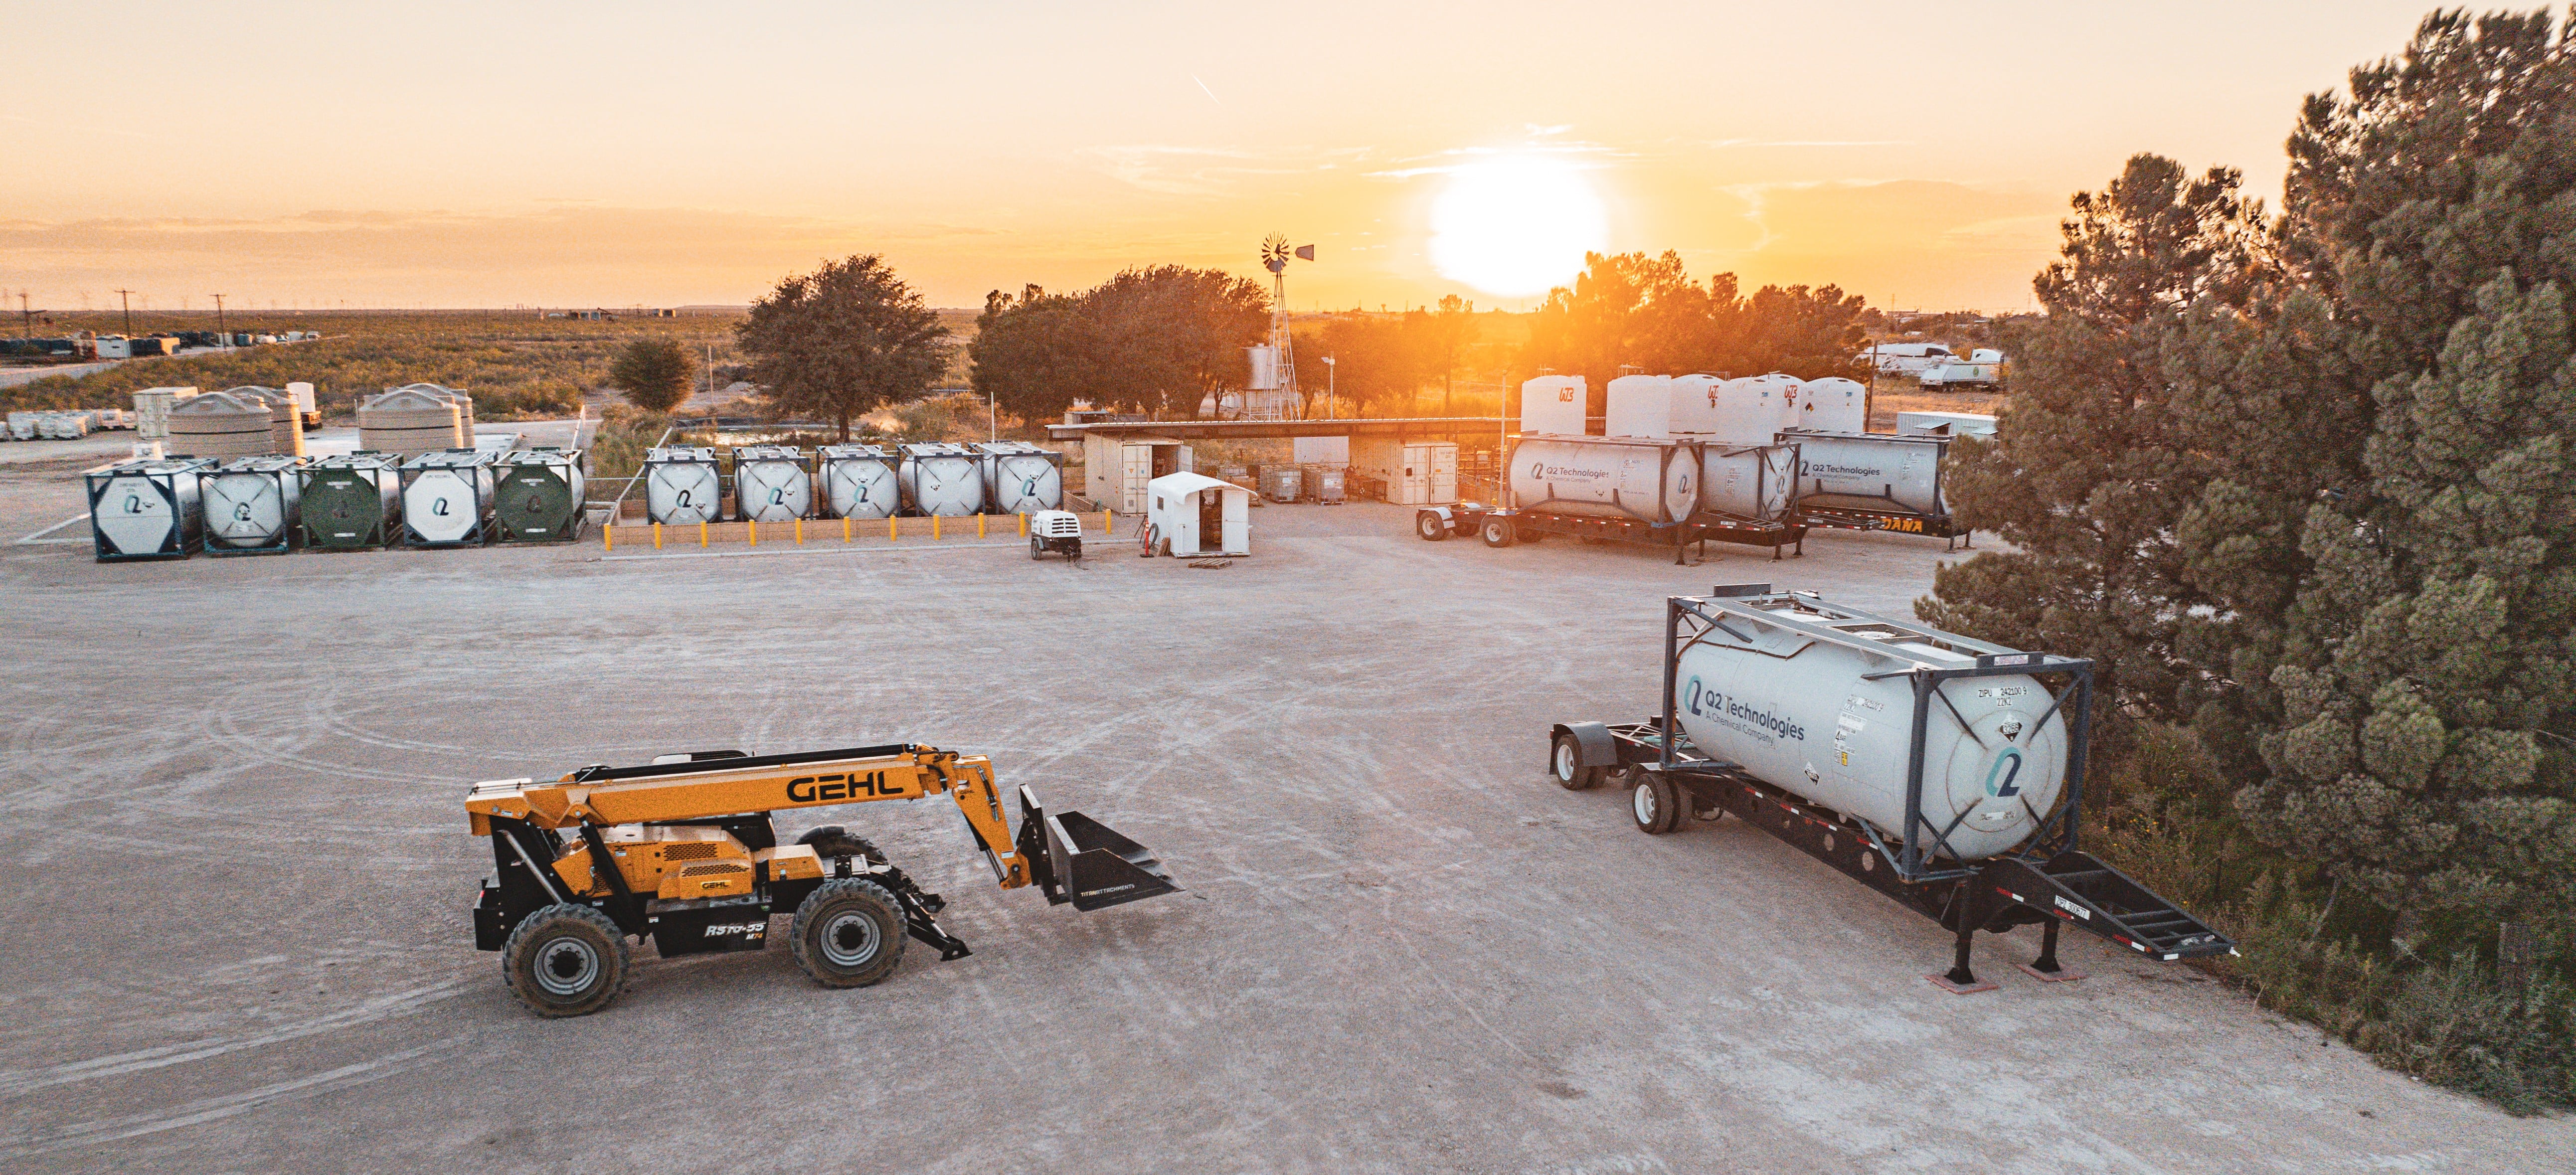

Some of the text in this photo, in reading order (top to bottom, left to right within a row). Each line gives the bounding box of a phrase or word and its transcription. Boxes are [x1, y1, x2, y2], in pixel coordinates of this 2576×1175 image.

[1827, 465, 1880, 477] Technologies
[1882, 518, 1923, 532] DANA
[1978, 686, 2027, 697] ZIPU 242100 9
[1997, 697, 2012, 706] 22K2
[1706, 690, 1804, 741] Q2 Technologies
[1706, 710, 1774, 746] A Chemical Company
[787, 771, 903, 802] GEHL
[704, 922, 766, 937] RS10-55
